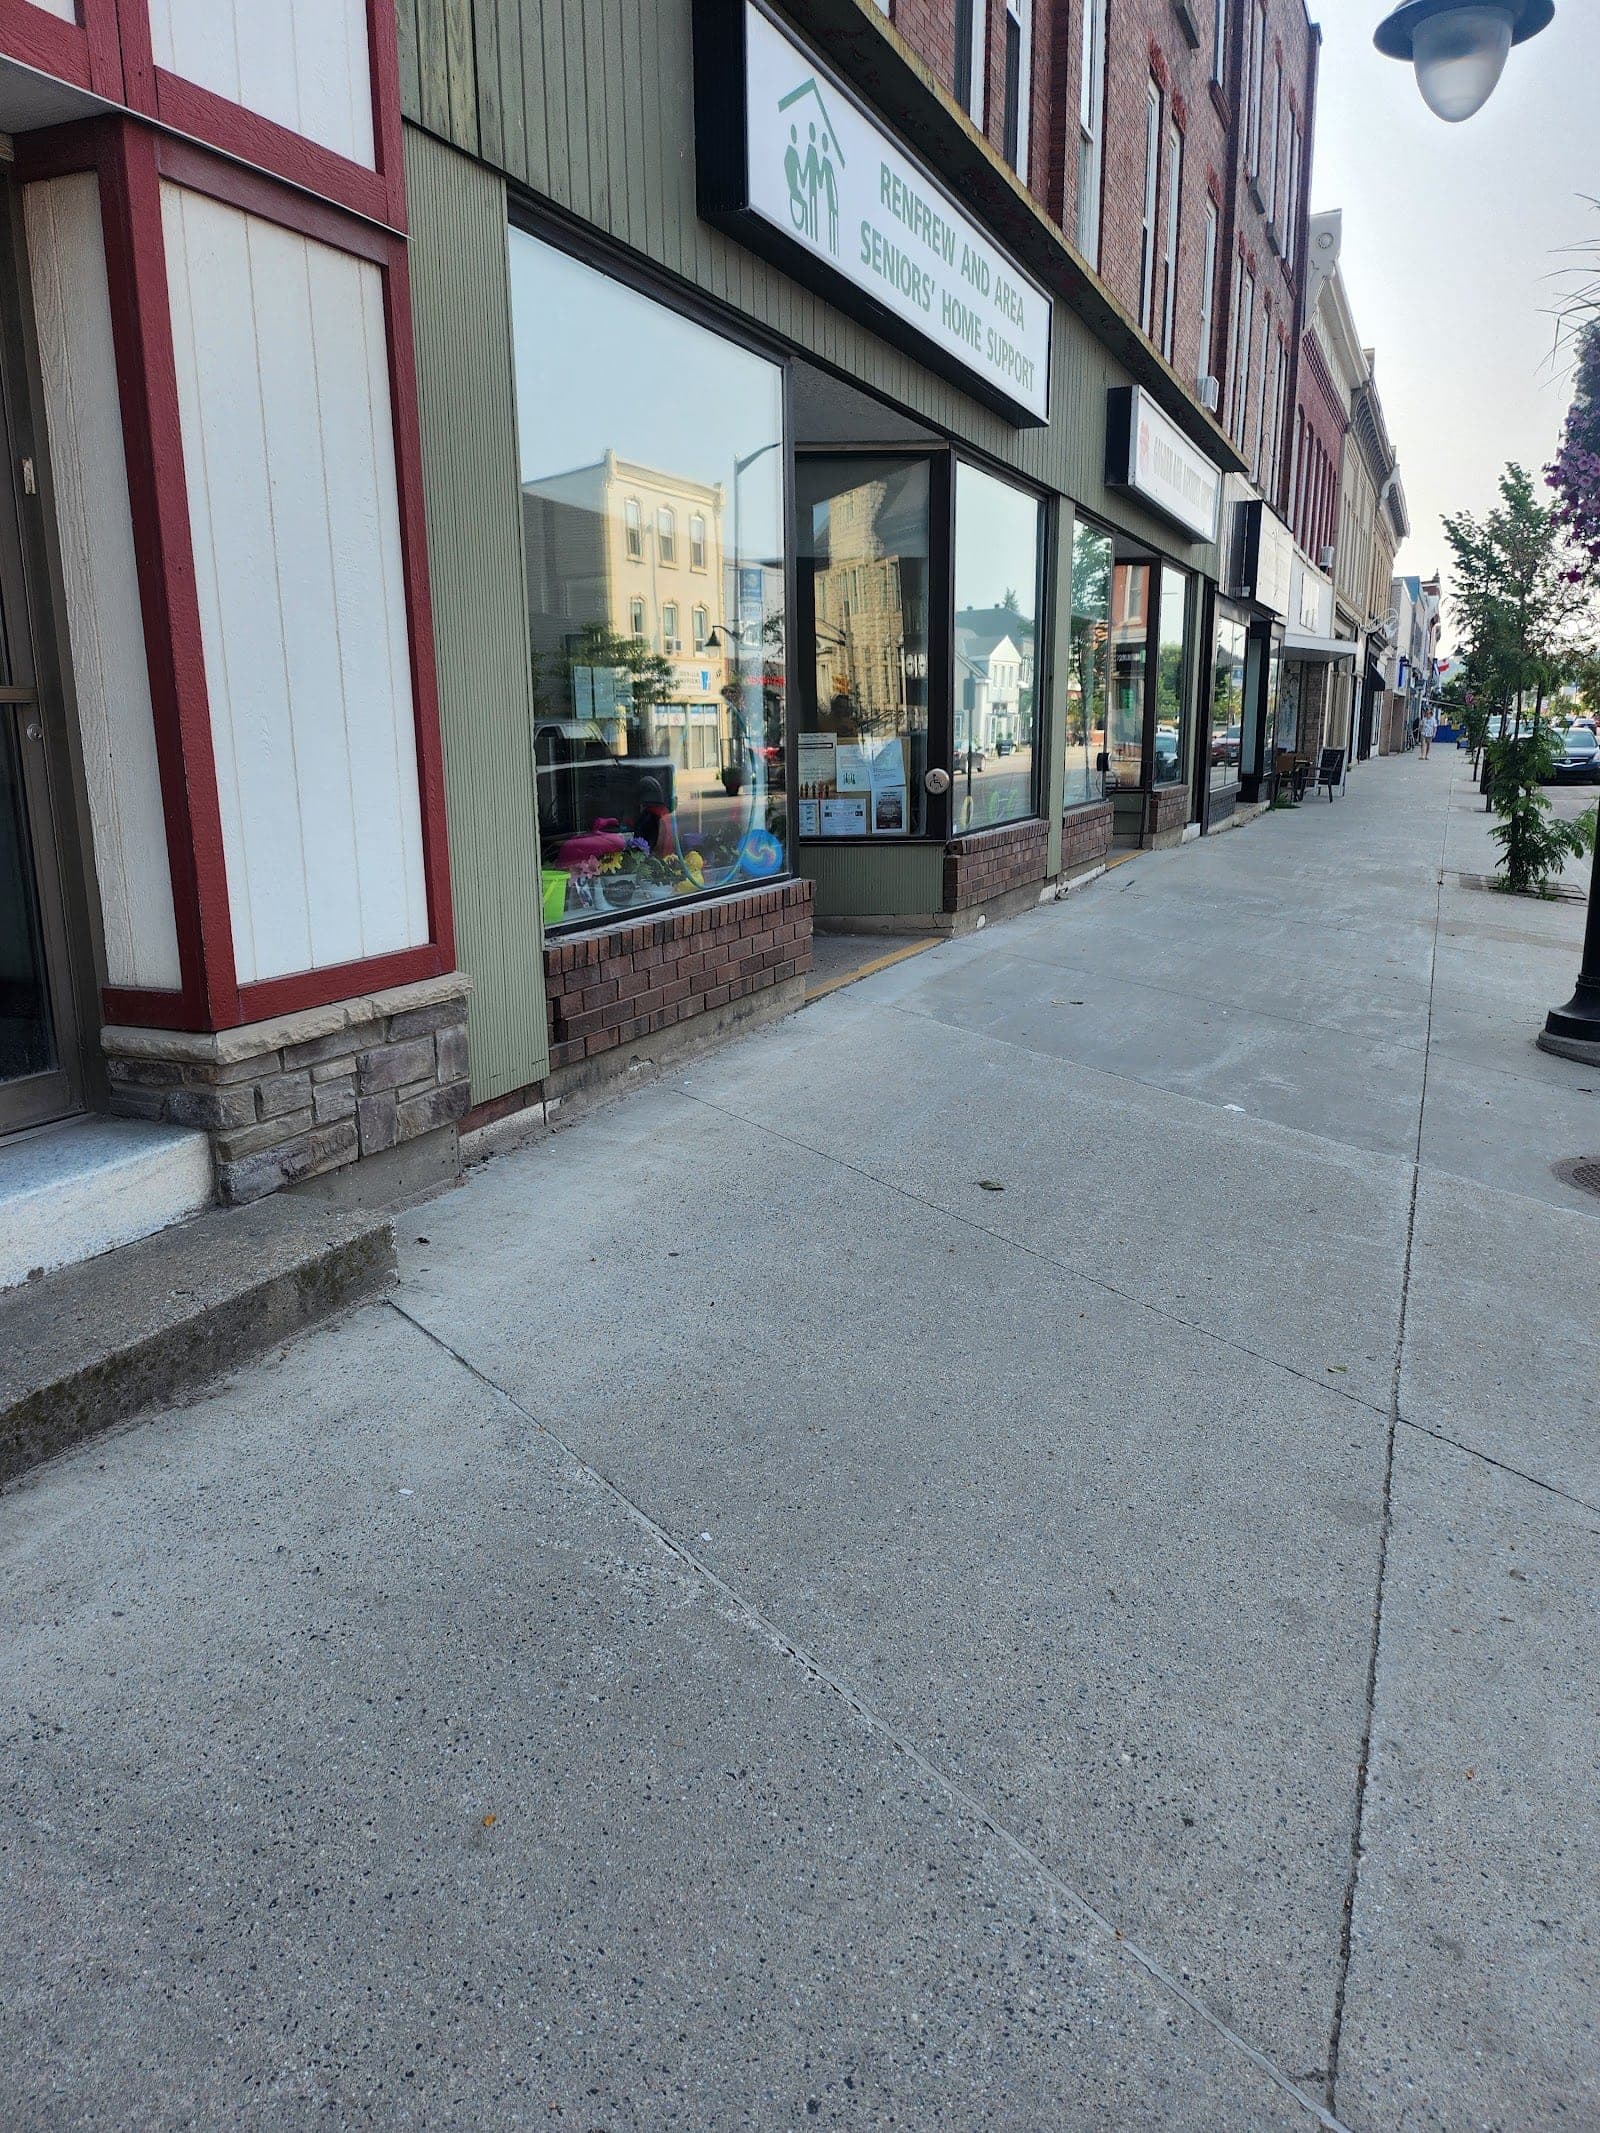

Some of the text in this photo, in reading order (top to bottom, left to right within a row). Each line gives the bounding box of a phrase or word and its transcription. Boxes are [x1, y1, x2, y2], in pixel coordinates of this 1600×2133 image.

[860, 220, 1034, 392] SENIORS' HOME SUPPORT
[880, 160, 1025, 331] RENFREW AND AREA
